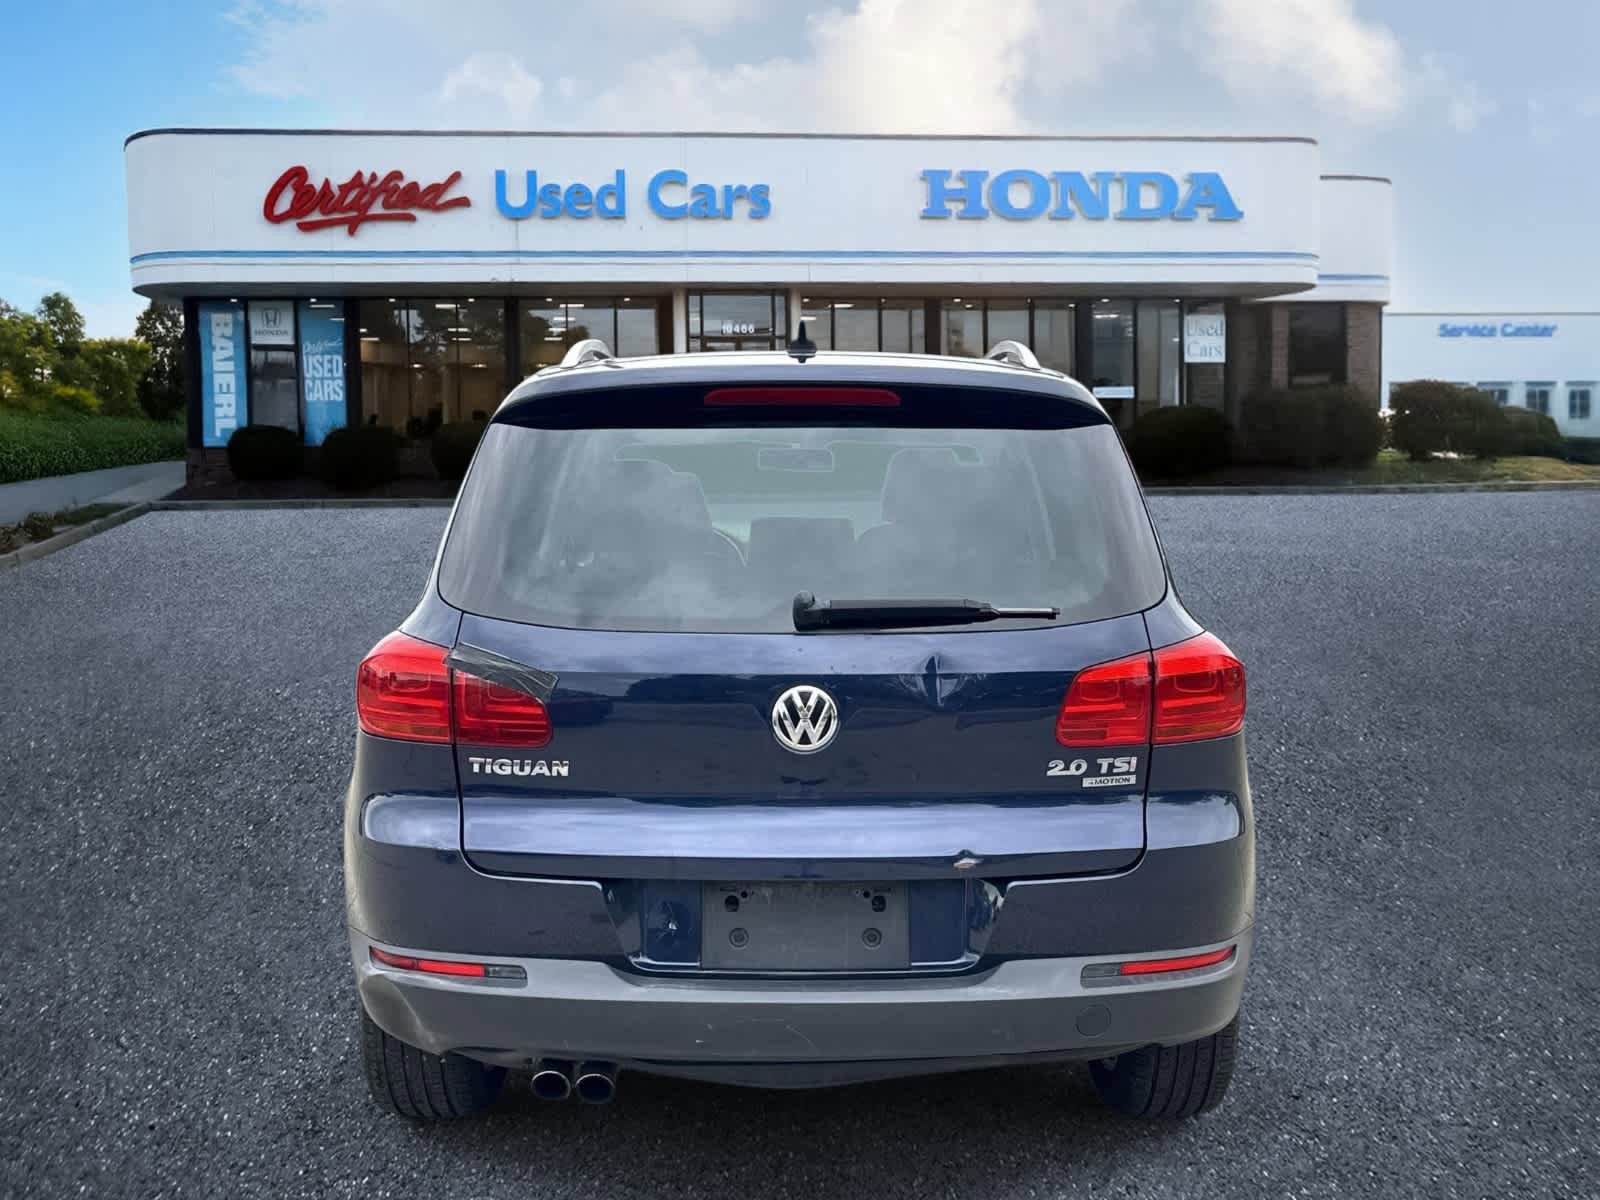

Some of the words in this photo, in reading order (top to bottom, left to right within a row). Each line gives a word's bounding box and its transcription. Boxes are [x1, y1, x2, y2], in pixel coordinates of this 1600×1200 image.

[264, 166, 471, 236] Certified
[495, 169, 625, 220] Used
[648, 169, 771, 220] Cars
[920, 169, 1244, 221] HONDA
[254, 329, 288, 337] HONDA
[1187, 319, 1224, 336] Used
[1439, 324, 1497, 336] Service
[1501, 323, 1558, 336] Center
[1187, 341, 1223, 357] Cars
[210, 313, 237, 437] BAIERL
[303, 354, 342, 376] USED
[304, 379, 343, 401] CARS
[468, 757, 569, 777] TIGUAN
[1097, 757, 1137, 774] TSI
